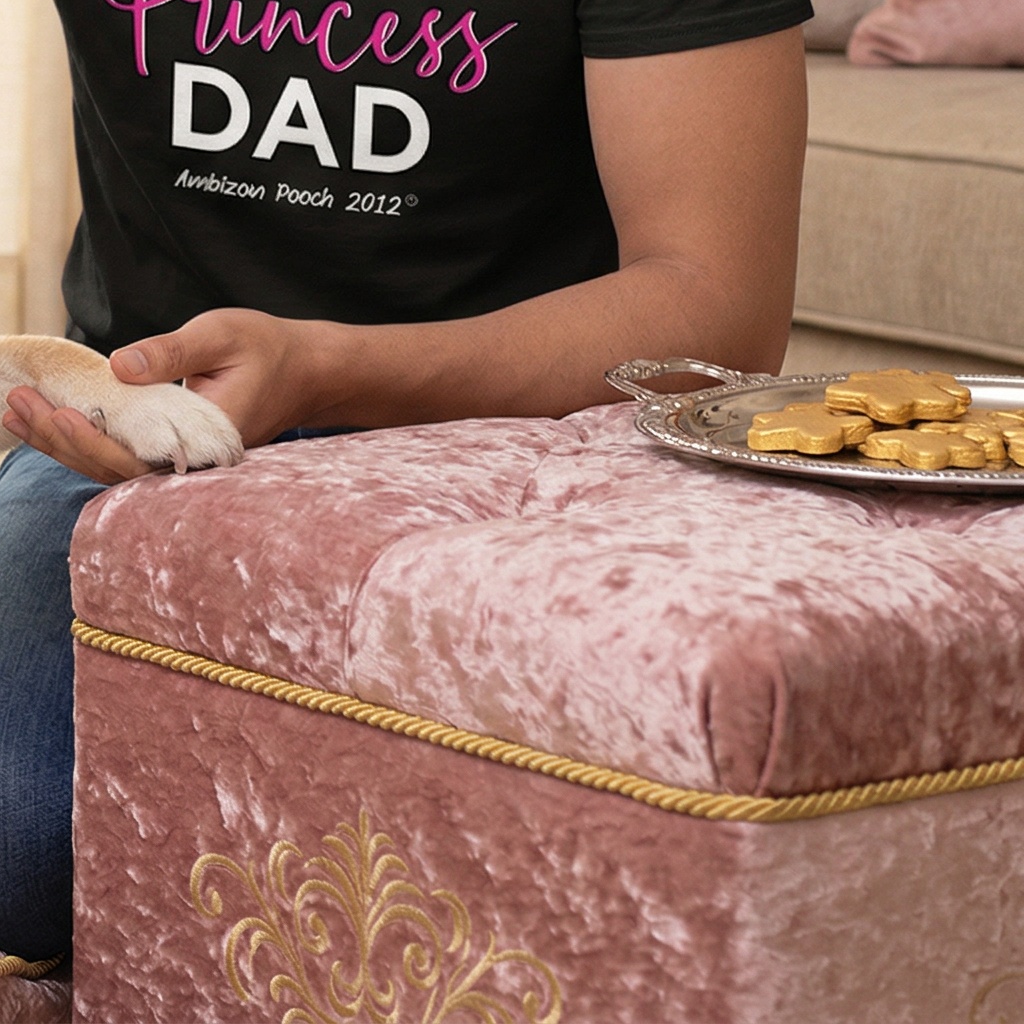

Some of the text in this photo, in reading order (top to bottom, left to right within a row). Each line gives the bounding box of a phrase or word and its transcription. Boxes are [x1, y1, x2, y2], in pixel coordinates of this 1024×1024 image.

[171, 61, 431, 174] DAD
[174, 168, 266, 200] Ambizon
[275, 182, 335, 209] Pooch
